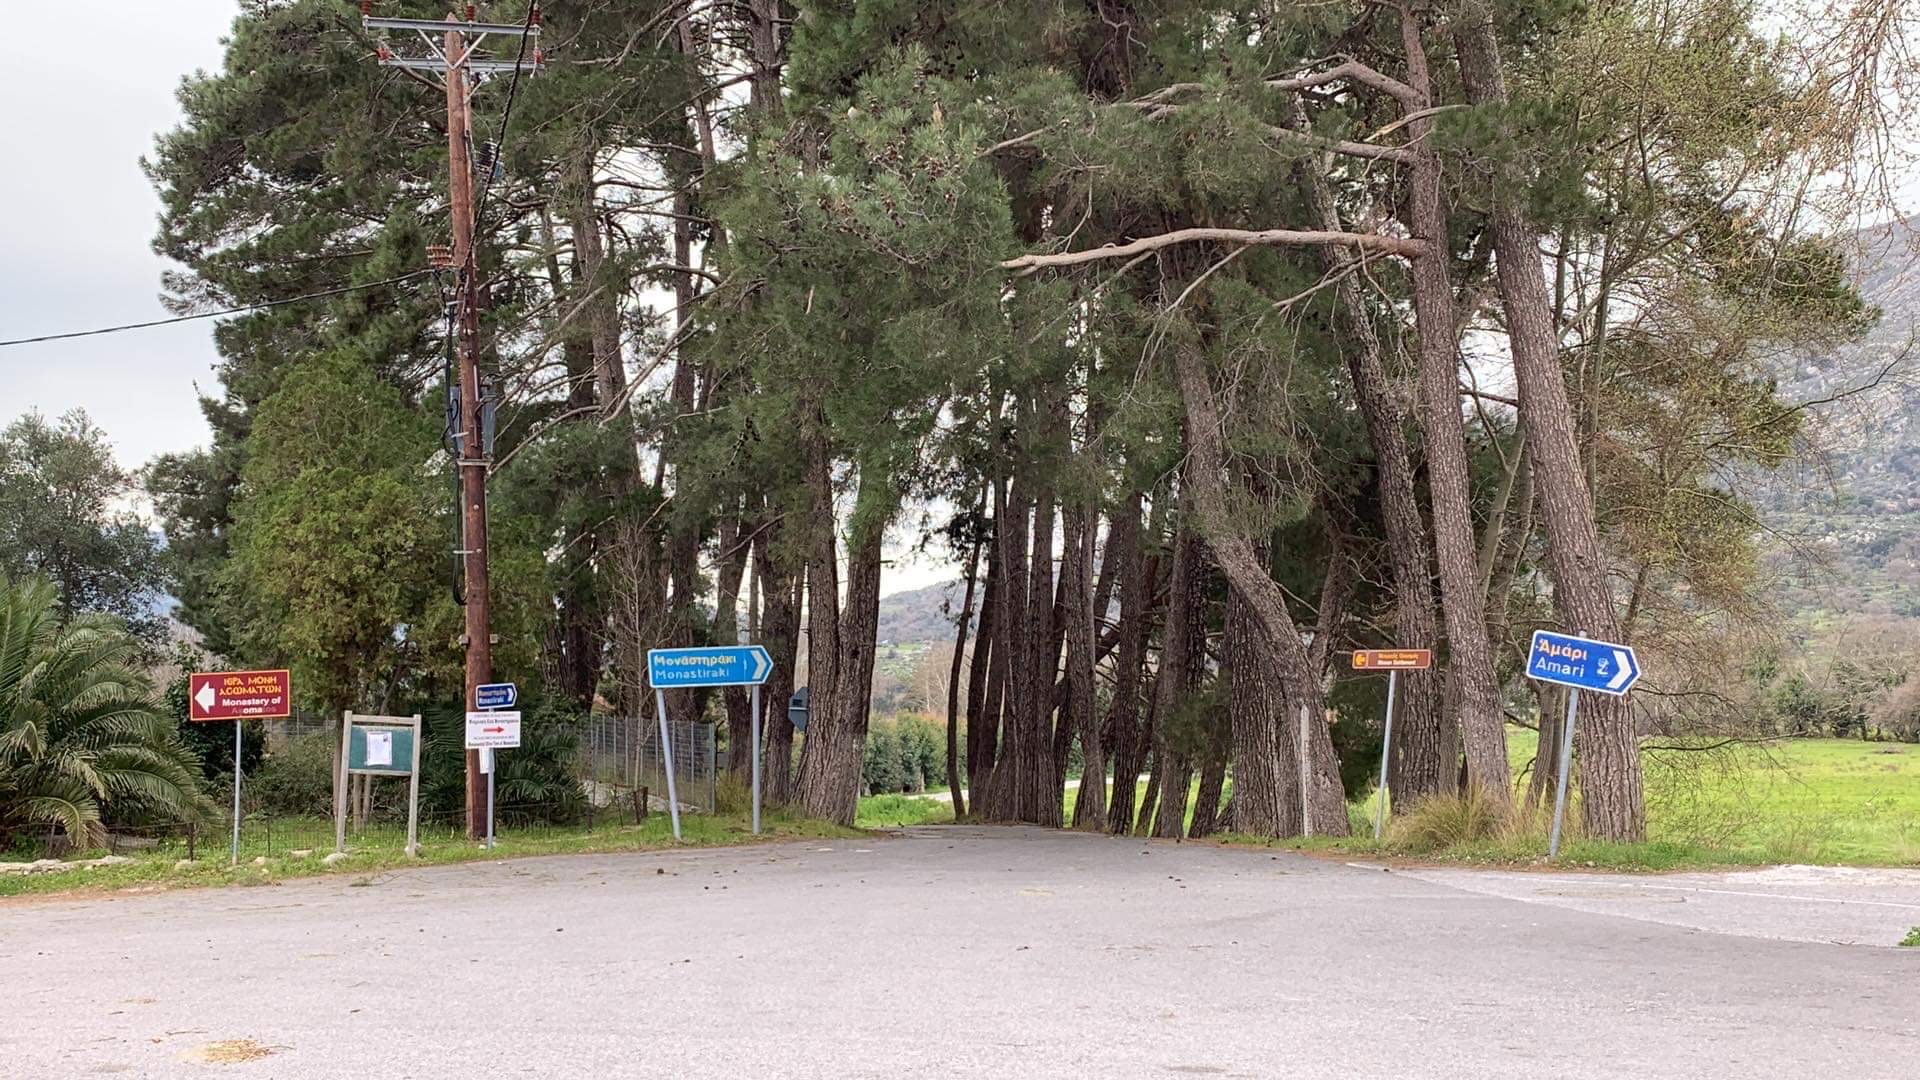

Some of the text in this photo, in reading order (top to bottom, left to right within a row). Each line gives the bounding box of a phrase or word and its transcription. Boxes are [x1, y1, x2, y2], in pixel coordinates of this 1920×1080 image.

[1535, 656, 1585, 677] Amari
[655, 668, 730, 680] Monastiraki
[222, 696, 282, 707] Monastery of
